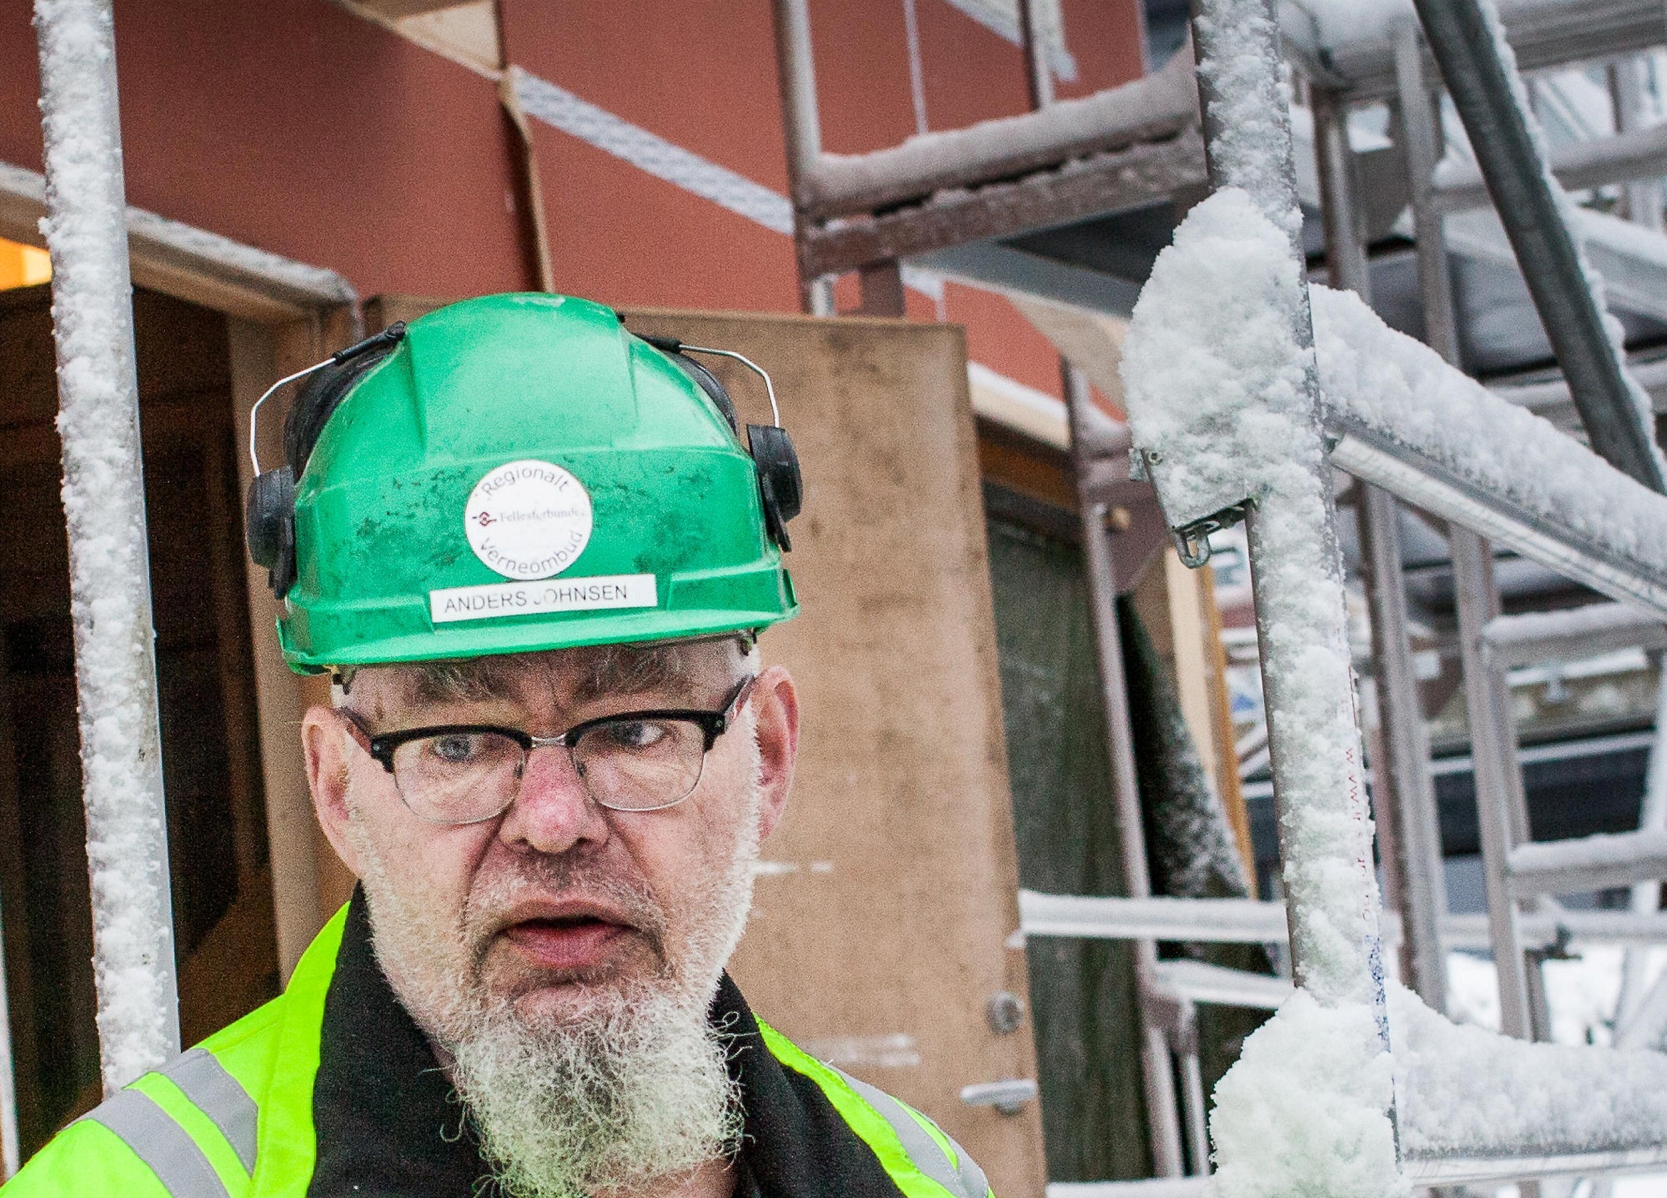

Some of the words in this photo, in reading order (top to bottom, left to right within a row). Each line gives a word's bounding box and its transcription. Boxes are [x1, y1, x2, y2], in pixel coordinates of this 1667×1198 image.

[481, 467, 570, 497] Regionalt
[480, 531, 583, 574] Verneombud
[444, 590, 527, 613] ANDERS
